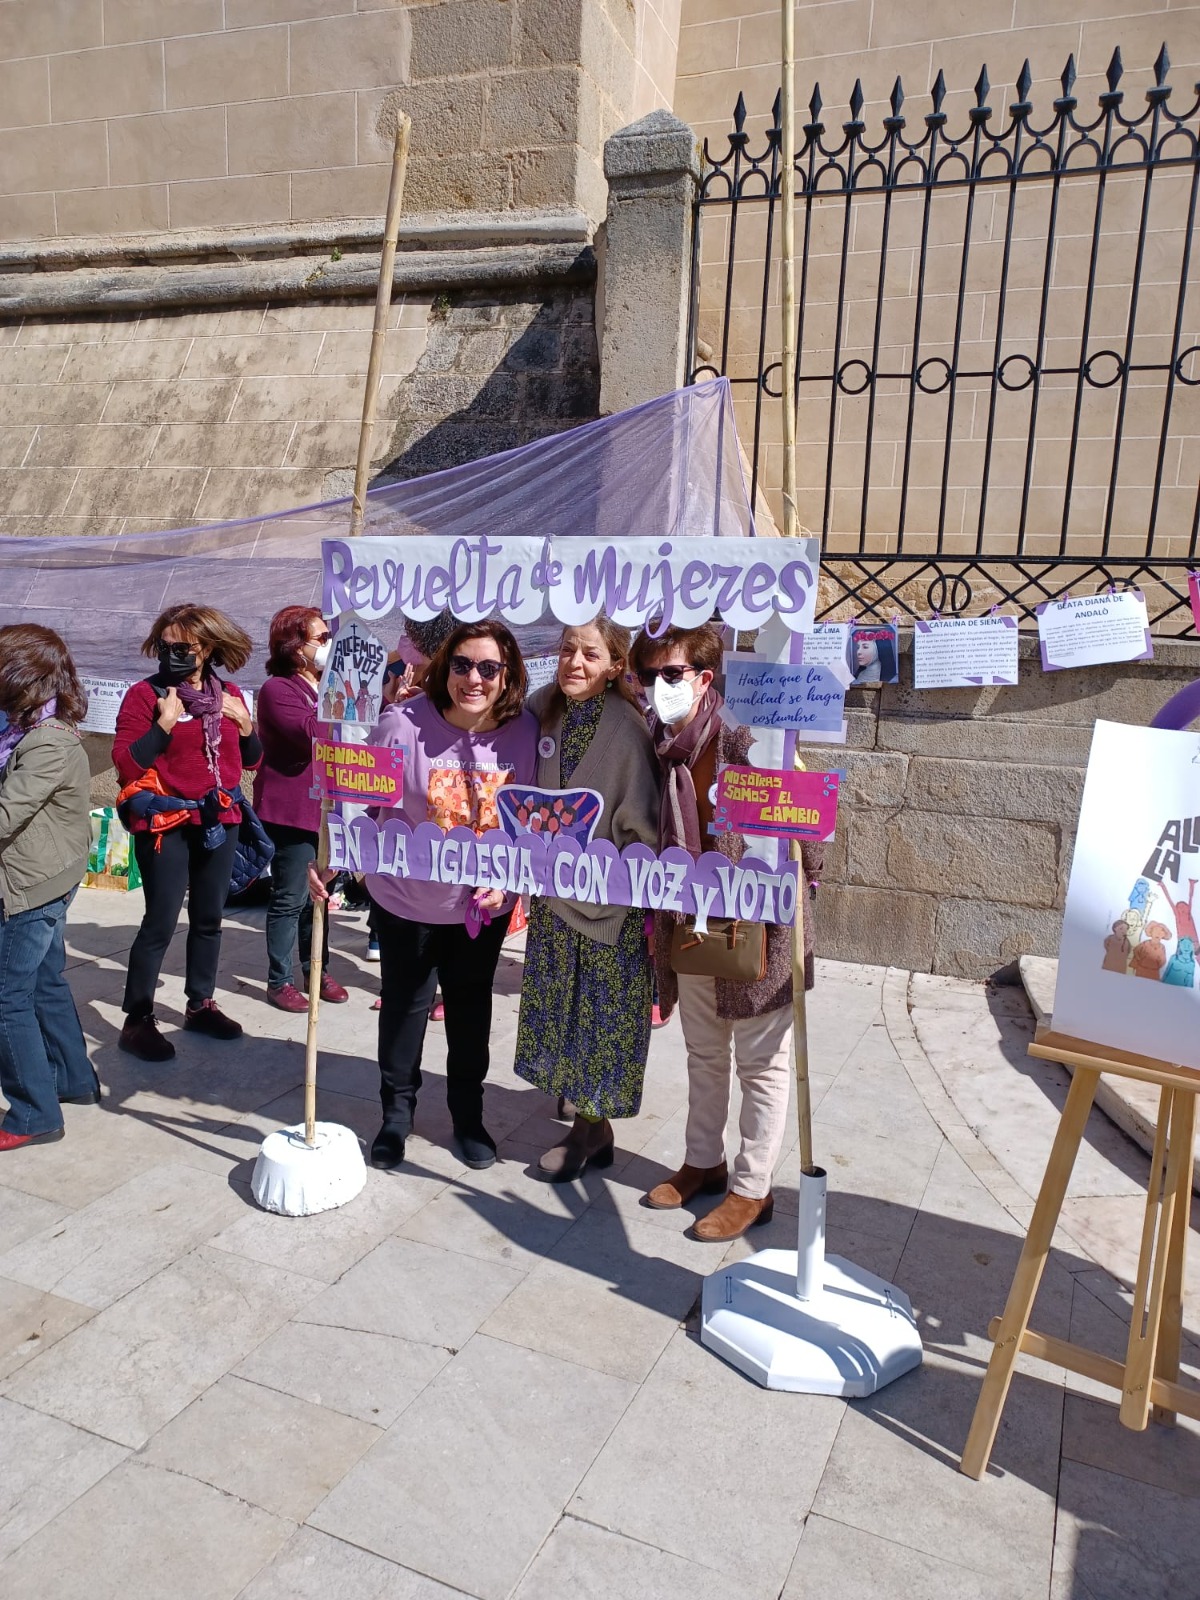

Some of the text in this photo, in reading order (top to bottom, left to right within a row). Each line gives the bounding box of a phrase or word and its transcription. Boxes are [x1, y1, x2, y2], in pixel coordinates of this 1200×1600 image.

[321, 533, 813, 639] Revuelta de Mujeres
[1057, 601, 1083, 610] BEATA
[1085, 597, 1111, 606] DIANA
[929, 621, 966, 629] CATALINA
[335, 636, 384, 662] ALCEMOS
[331, 654, 381, 675] LA VOZ
[738, 667, 824, 687] Hasta que la
[726, 686, 843, 710] igualdad se haga
[752, 707, 818, 725] costumbre
[316, 742, 376, 768] DIGNIDAD
[430, 758, 444, 767] YO
[446, 759, 467, 769] SOY
[326, 763, 396, 793] E IGUALDAD
[723, 770, 783, 788] NOSOTRAS
[723, 785, 794, 804] SOMOS EL
[760, 806, 821, 825] CAMBIO
[327, 822, 362, 870] EN
[376, 830, 411, 879] LA
[430, 838, 544, 897] IGLESIA,
[553, 851, 613, 905] CON
[626, 857, 688, 912] VOZ
[716, 866, 797, 924] VOTO
[1141, 847, 1181, 884] LA
